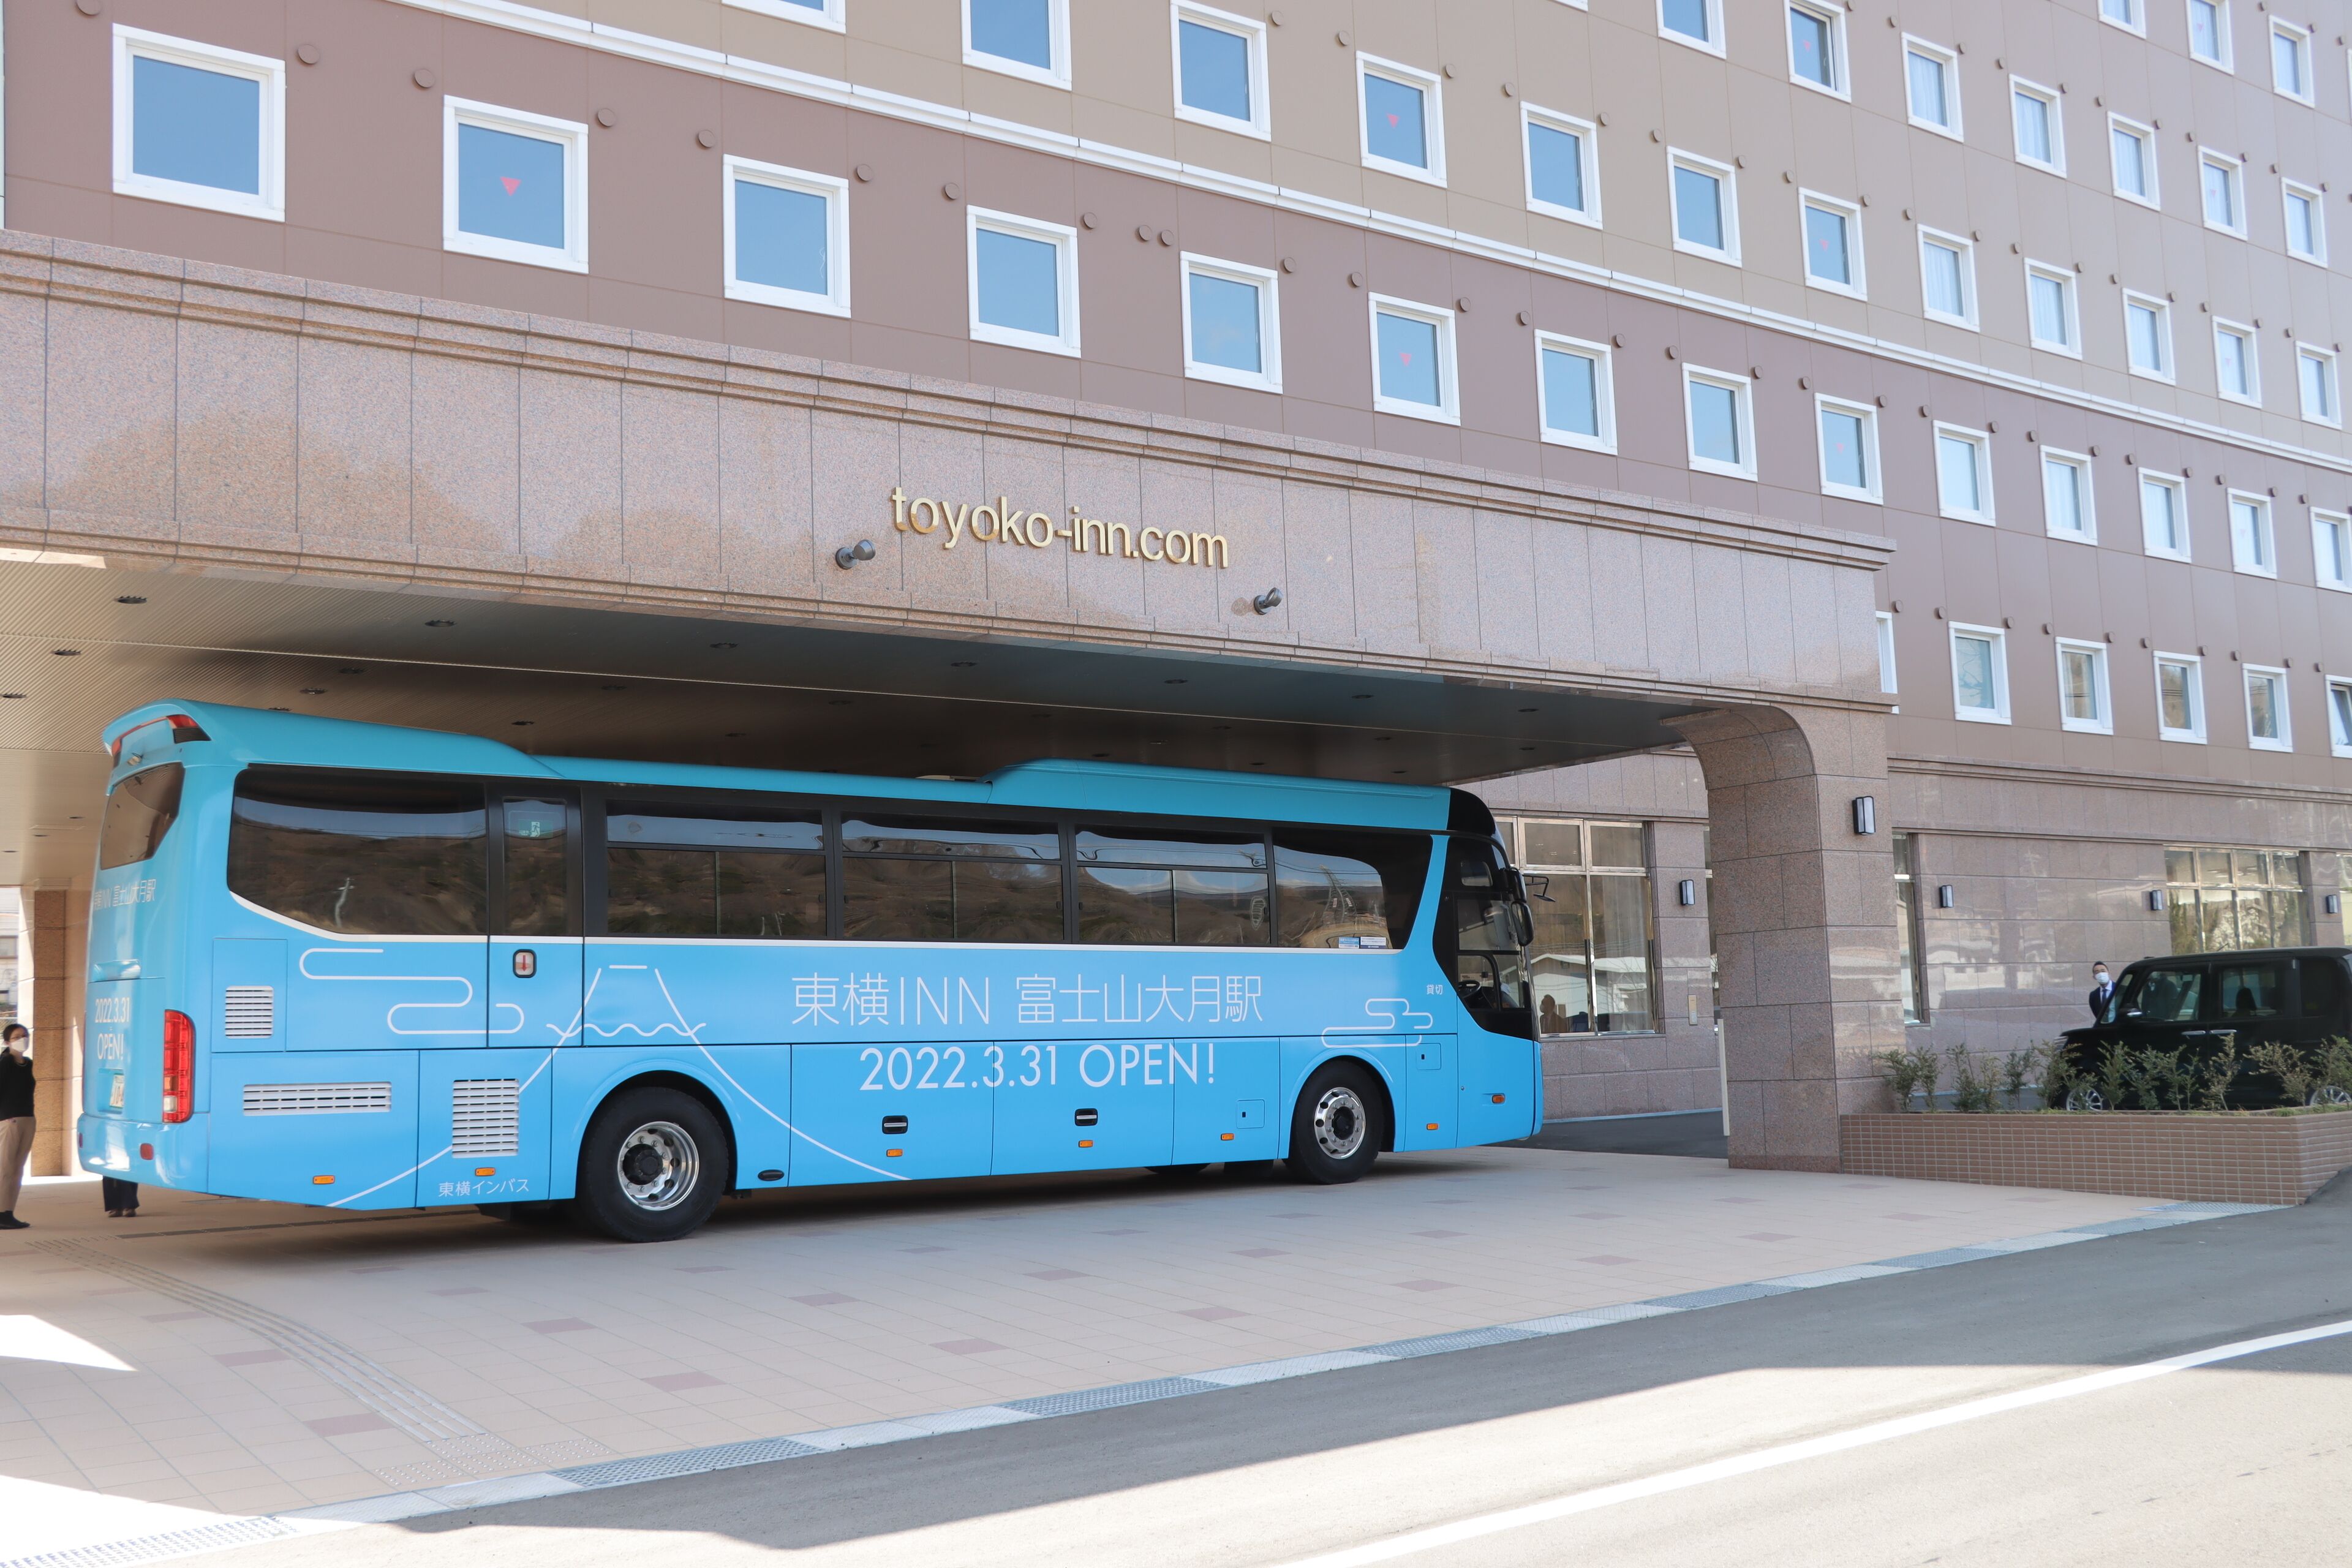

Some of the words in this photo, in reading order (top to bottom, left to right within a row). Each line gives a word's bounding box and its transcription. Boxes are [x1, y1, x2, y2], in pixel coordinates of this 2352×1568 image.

[891, 486, 1229, 568] toyoko-inn.com
[791, 972, 990, 1026] 東横INN
[1016, 973, 1263, 1023] 富士山大月駅
[1426, 984, 1444, 995] 貸切
[95, 997, 130, 1023] 2022.3.31
[97, 1033, 124, 1060] OPEN!
[859, 1045, 1057, 1091] 2022.3.31
[1079, 1042, 1215, 1088] OPEN!
[439, 1177, 530, 1197] 東横インバス
